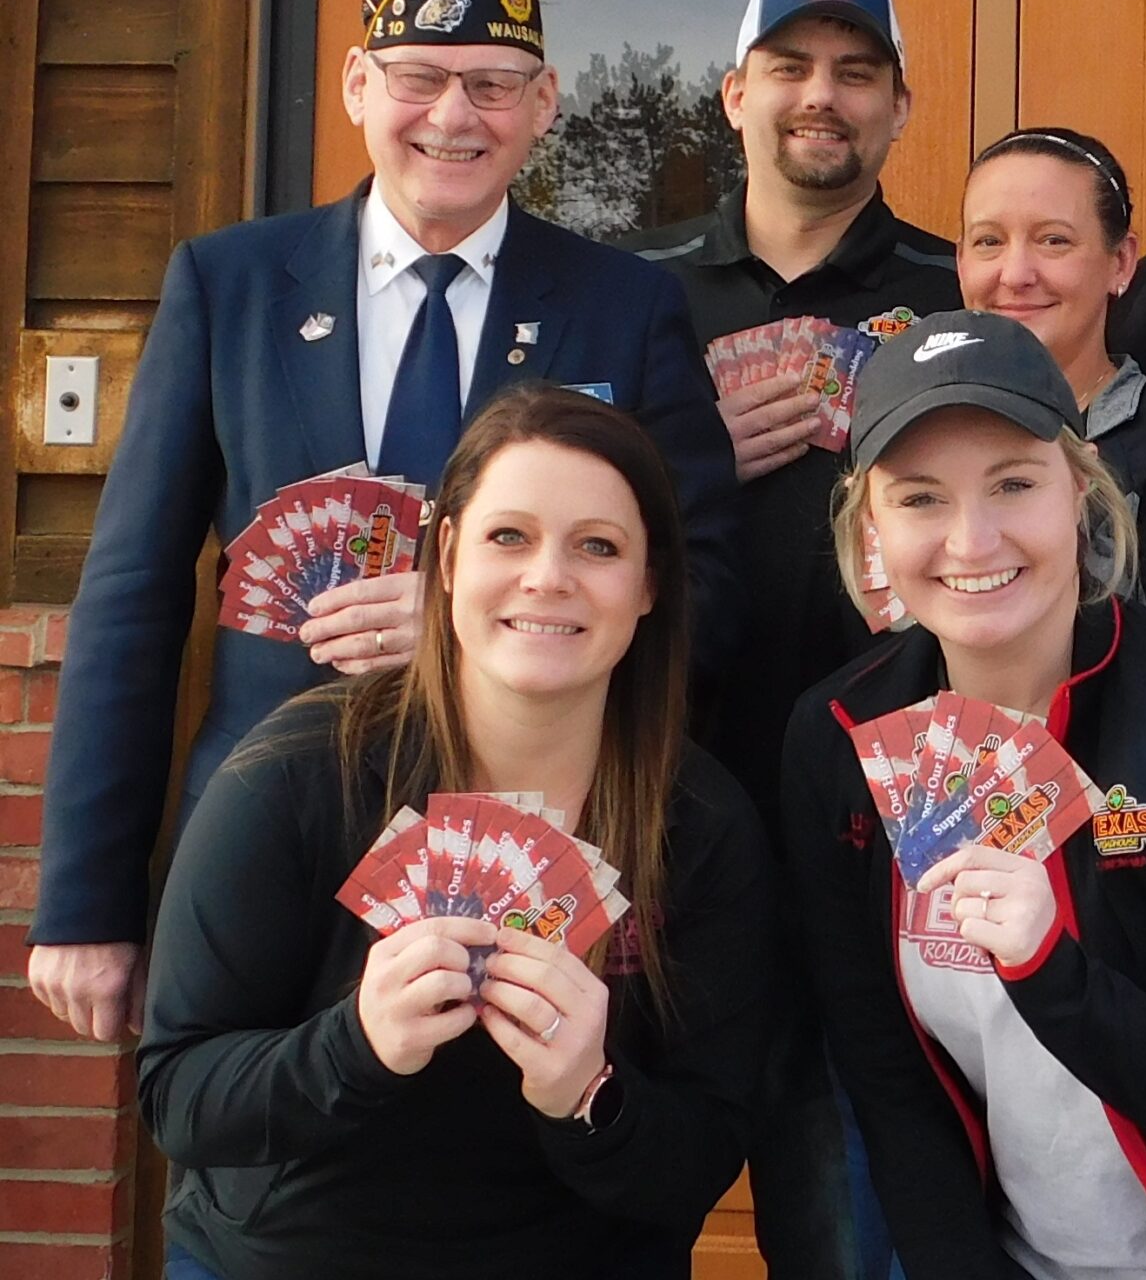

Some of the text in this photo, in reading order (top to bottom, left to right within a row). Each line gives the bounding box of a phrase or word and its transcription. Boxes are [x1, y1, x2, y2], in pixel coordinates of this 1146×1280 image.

[388, 21, 405, 35] 10
[924, 331, 970, 350] NIKE
[333, 529, 346, 550] Our
[273, 578, 292, 596] Our
[274, 622, 296, 635] Our
[927, 764, 944, 789] Our
[888, 788, 903, 815] Our
[932, 794, 977, 836] Support
[973, 776, 998, 797] Our
[447, 867, 464, 896] Our
[488, 891, 513, 915] Our
[923, 941, 990, 965] ROADH
